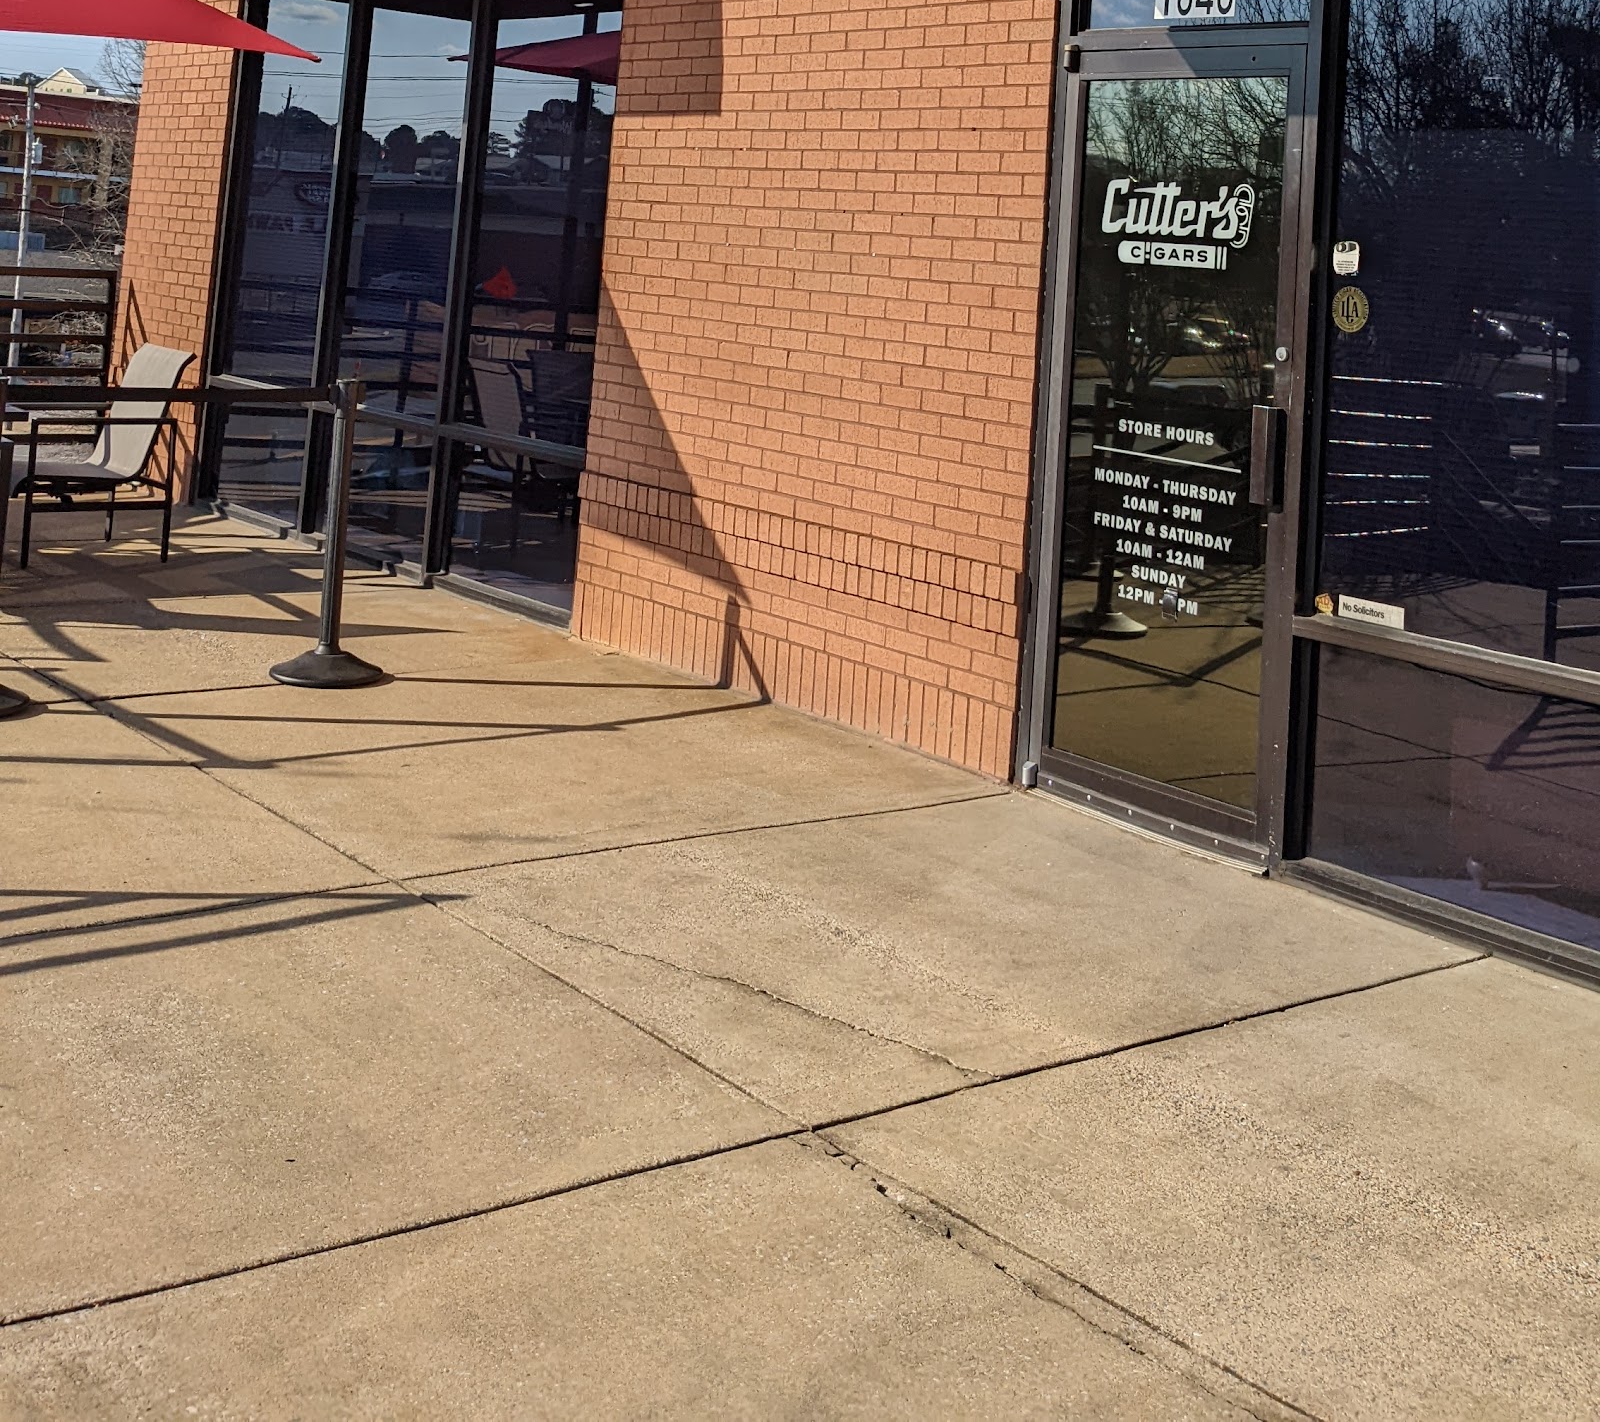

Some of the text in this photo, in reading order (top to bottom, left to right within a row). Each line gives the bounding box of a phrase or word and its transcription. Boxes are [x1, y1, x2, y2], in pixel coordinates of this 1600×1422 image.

[1101, 178, 1240, 239] Cutter's
[1130, 246, 1208, 263] CIGARS
[1118, 418, 1214, 446] STORE HOURS
[1094, 467, 1150, 490] MONDAY
[1162, 479, 1237, 506] THURSDAY
[1122, 495, 1160, 514] 10AM
[1172, 504, 1203, 523] 9PM
[1093, 511, 1233, 553] FRIDAY & SATURDAY
[1116, 538, 1152, 559] 10AM
[1166, 549, 1205, 570] 12AM
[1131, 564, 1186, 589] SUNDAY
[1117, 584, 1155, 605] 12PM
[1171, 597, 1198, 616] PM
[1342, 601, 1352, 612] No
[1353, 604, 1385, 619] Solicitors
